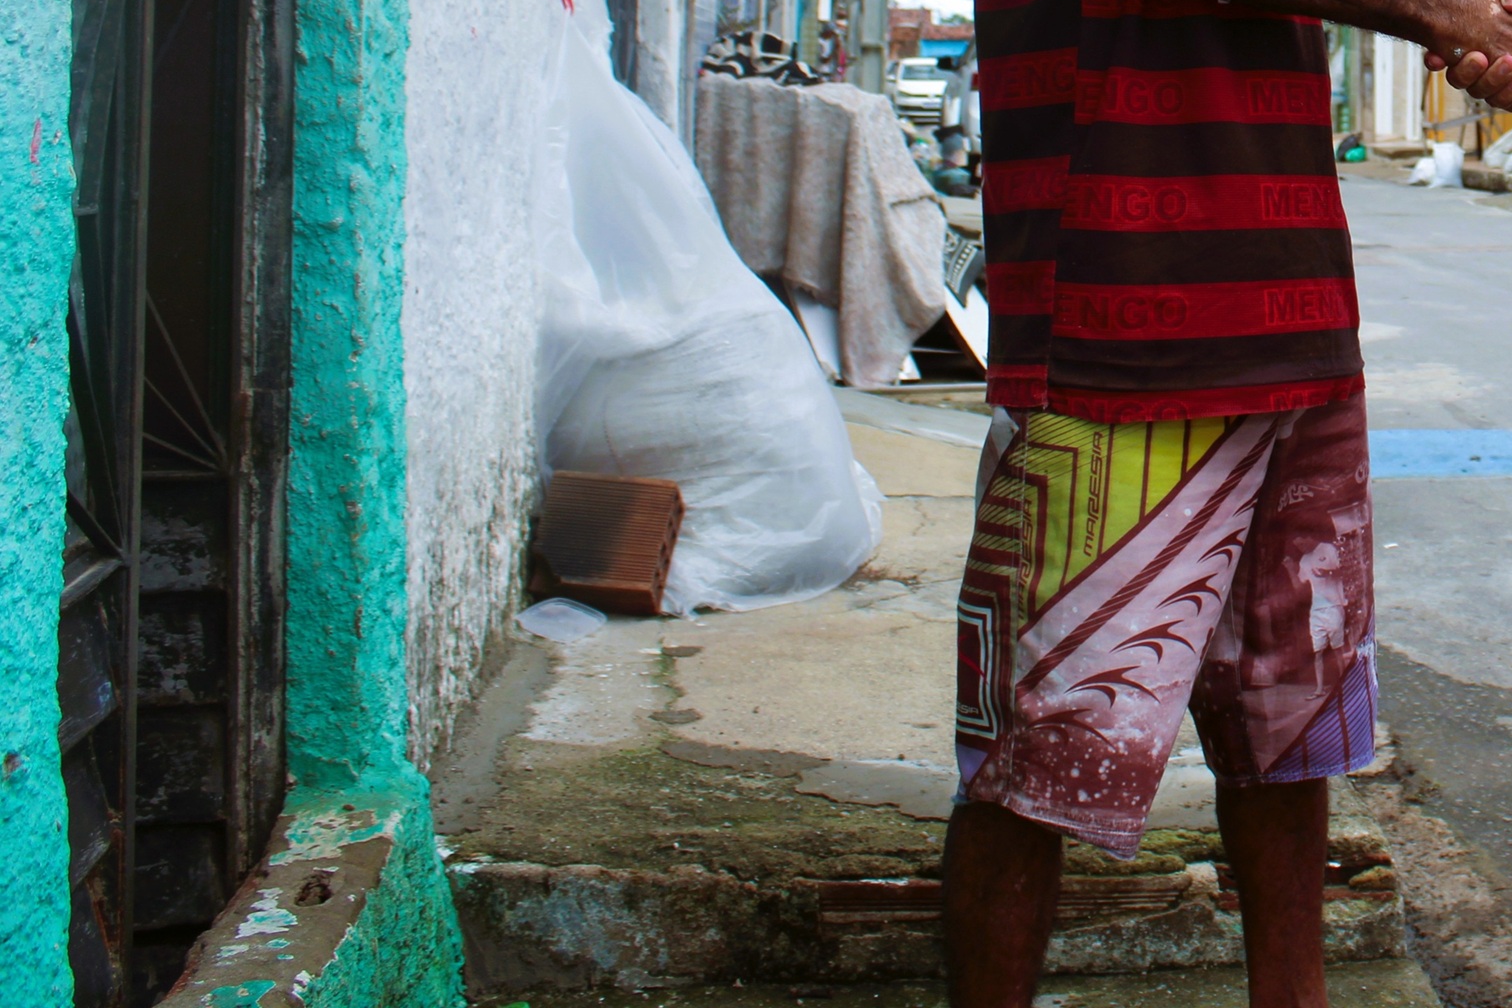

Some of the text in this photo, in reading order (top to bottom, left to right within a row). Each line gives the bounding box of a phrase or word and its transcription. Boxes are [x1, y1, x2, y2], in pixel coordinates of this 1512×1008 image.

[1249, 81, 1330, 114] MEN
[1062, 185, 1187, 221] ENGO
[1262, 183, 1342, 218] MEN
[1055, 291, 1188, 330] ENGO
[1266, 286, 1346, 324] MEN
[1084, 431, 1104, 557] MARESIA
